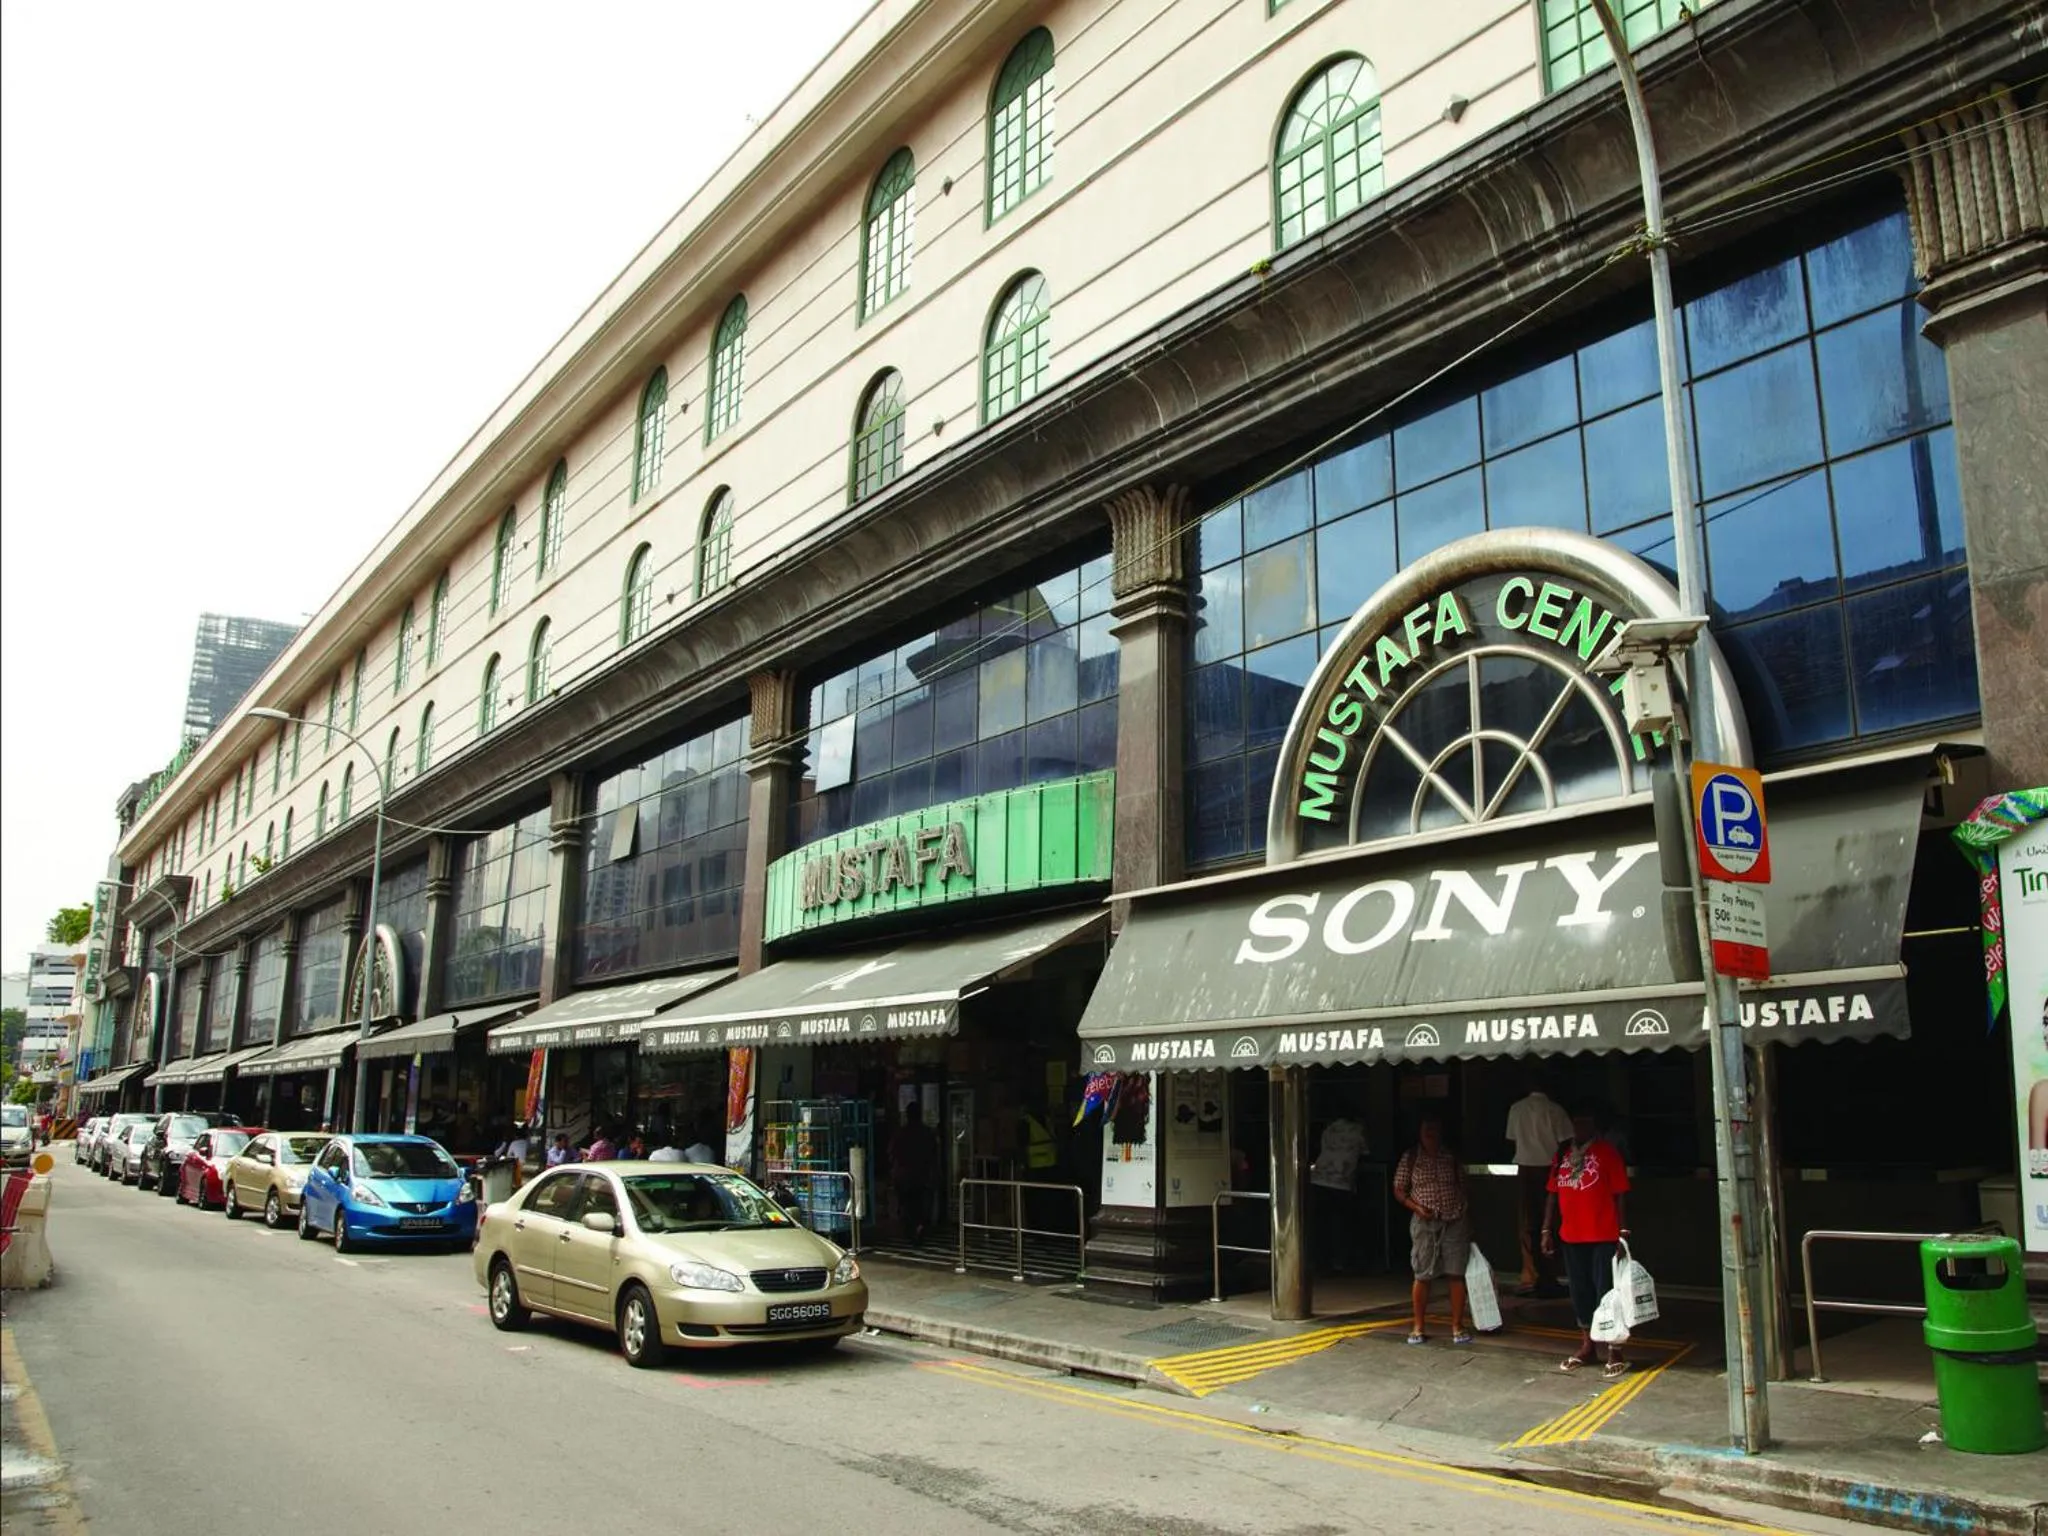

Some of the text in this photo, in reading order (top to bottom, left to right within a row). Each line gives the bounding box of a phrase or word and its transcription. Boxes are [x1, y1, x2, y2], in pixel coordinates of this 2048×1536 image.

[1299, 591, 1468, 821] MUSTAFA
[802, 821, 973, 911] MUSTAFA
[1234, 842, 1659, 964] SONY
[663, 1008, 947, 1044] MUSTAFA MUSTAFA MUSTAFA MUSTAFA
[1131, 1014, 1599, 1061] MUSTAFA MUSTAFA MUSTAFA
[1702, 994, 1874, 1031] USTAFA
